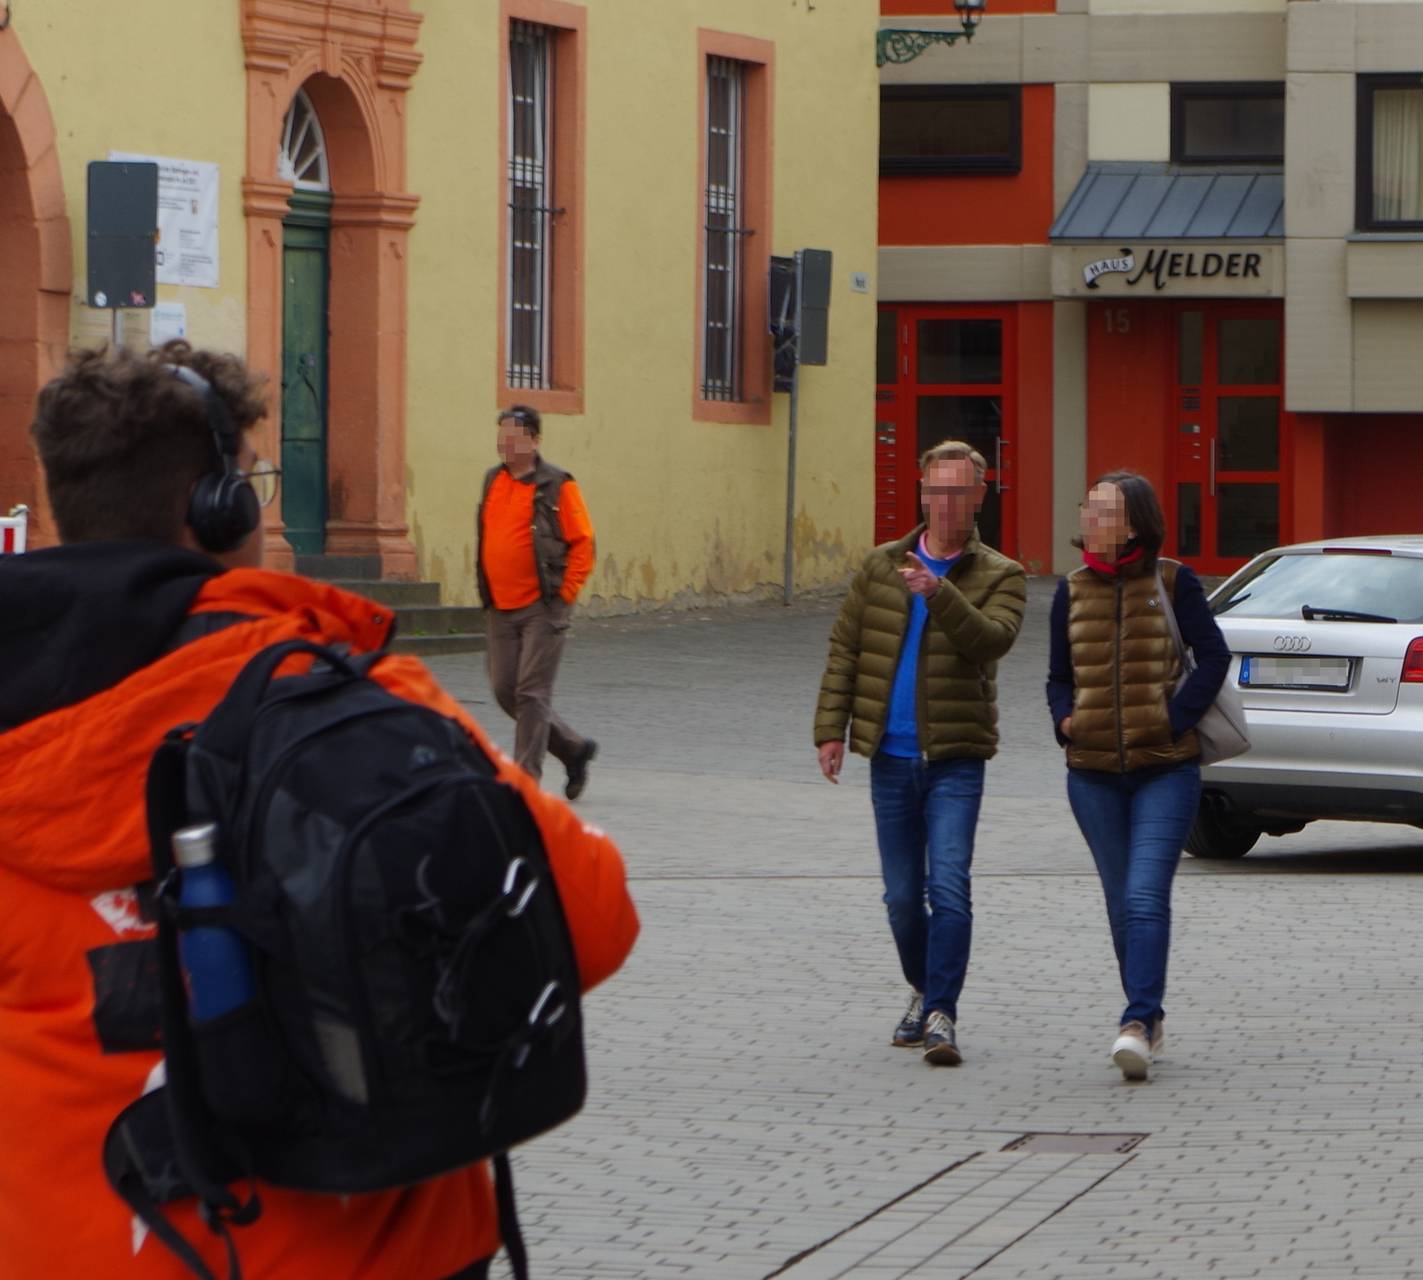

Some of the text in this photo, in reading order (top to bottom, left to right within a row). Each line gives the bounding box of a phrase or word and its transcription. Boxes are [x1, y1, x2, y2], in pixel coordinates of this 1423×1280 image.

[1090, 247, 1263, 290] HAUS MELDER
[1104, 309, 1130, 333] 15
